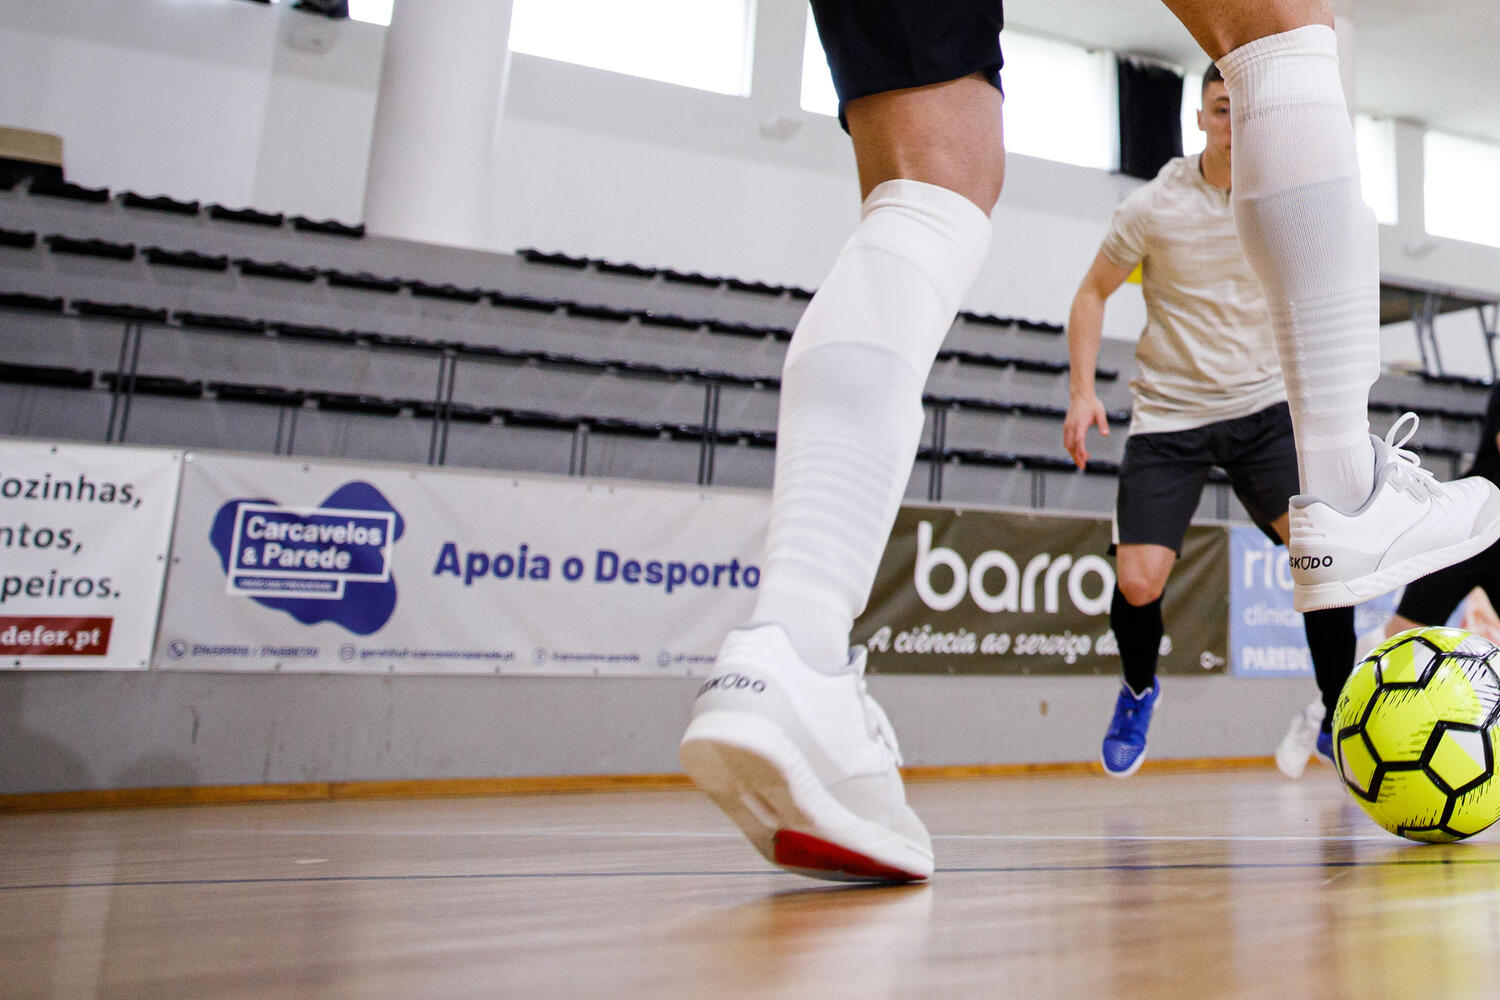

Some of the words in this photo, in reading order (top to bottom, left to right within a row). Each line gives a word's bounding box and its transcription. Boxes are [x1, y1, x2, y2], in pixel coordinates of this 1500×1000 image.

[0, 473, 142, 509] ozinhas,
[246, 515, 383, 546] Carcavelos
[241, 547, 258, 565] &
[262, 542, 351, 570] Parede
[434, 542, 551, 586] Apoia
[562, 556, 584, 582] o
[594, 549, 762, 594] Desporto
[914, 520, 1116, 615] barra
[0, 569, 120, 604] peiros.
[0, 625, 100, 651] defer.pt
[868, 625, 893, 653] A
[894, 624, 978, 654] ciência
[980, 633, 1011, 654] ao
[1013, 630, 1092, 665] serviço
